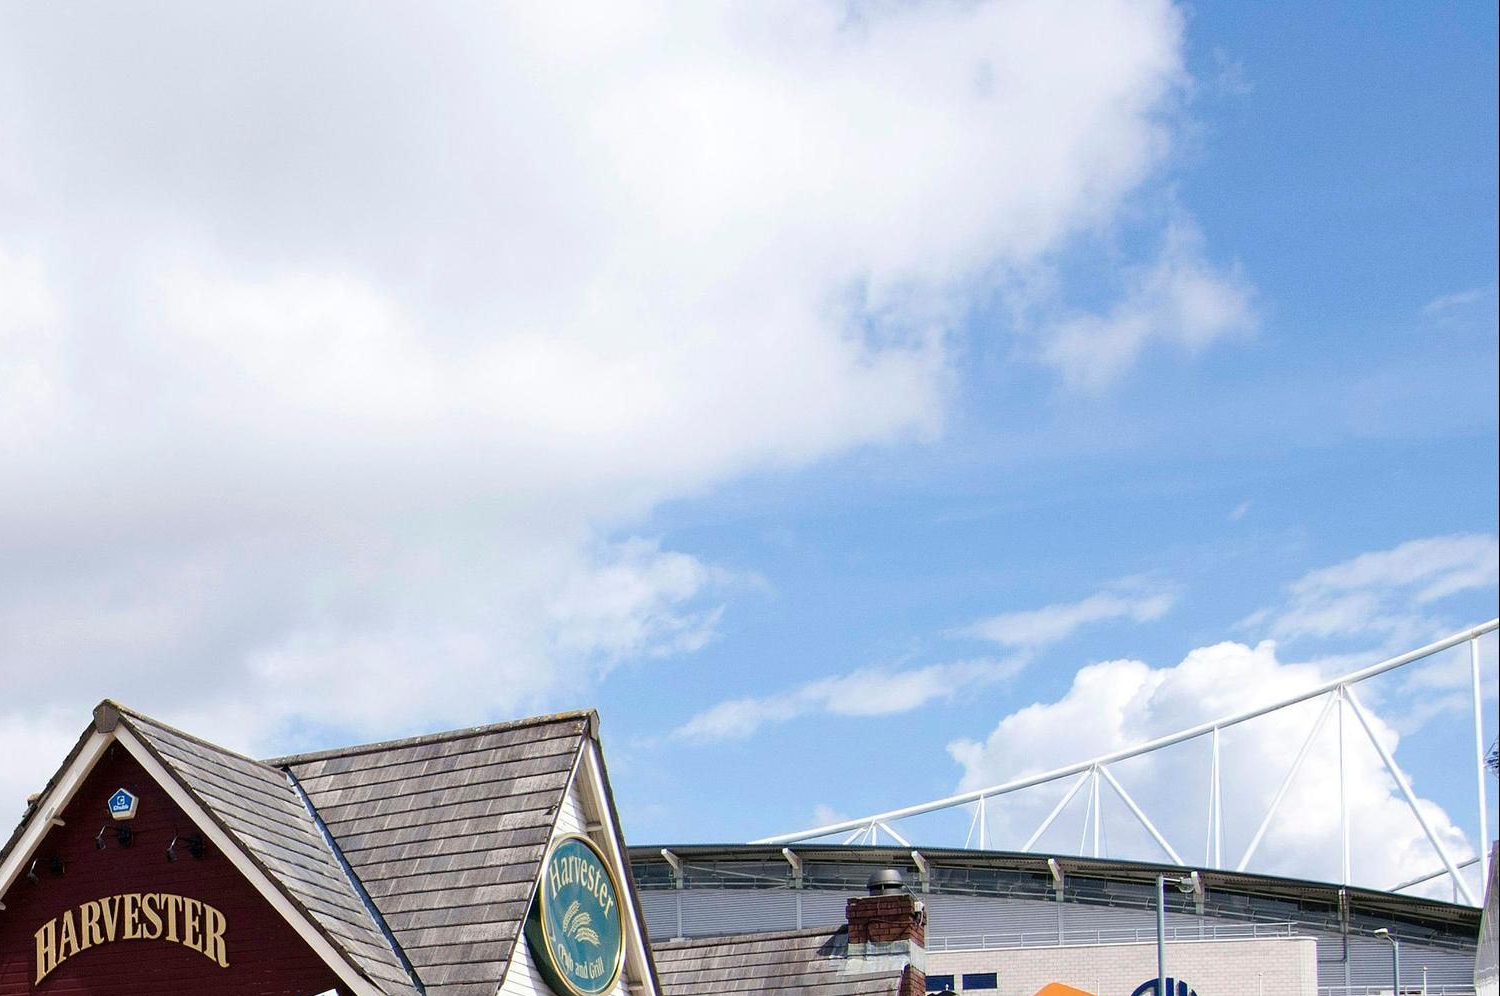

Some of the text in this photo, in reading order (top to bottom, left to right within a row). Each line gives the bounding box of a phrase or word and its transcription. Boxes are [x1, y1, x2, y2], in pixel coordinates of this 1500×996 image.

[549, 855, 614, 919] Harvester
[34, 893, 230, 986] HARVESTER
[575, 961, 589, 979] and
[589, 957, 605, 979] Grill
